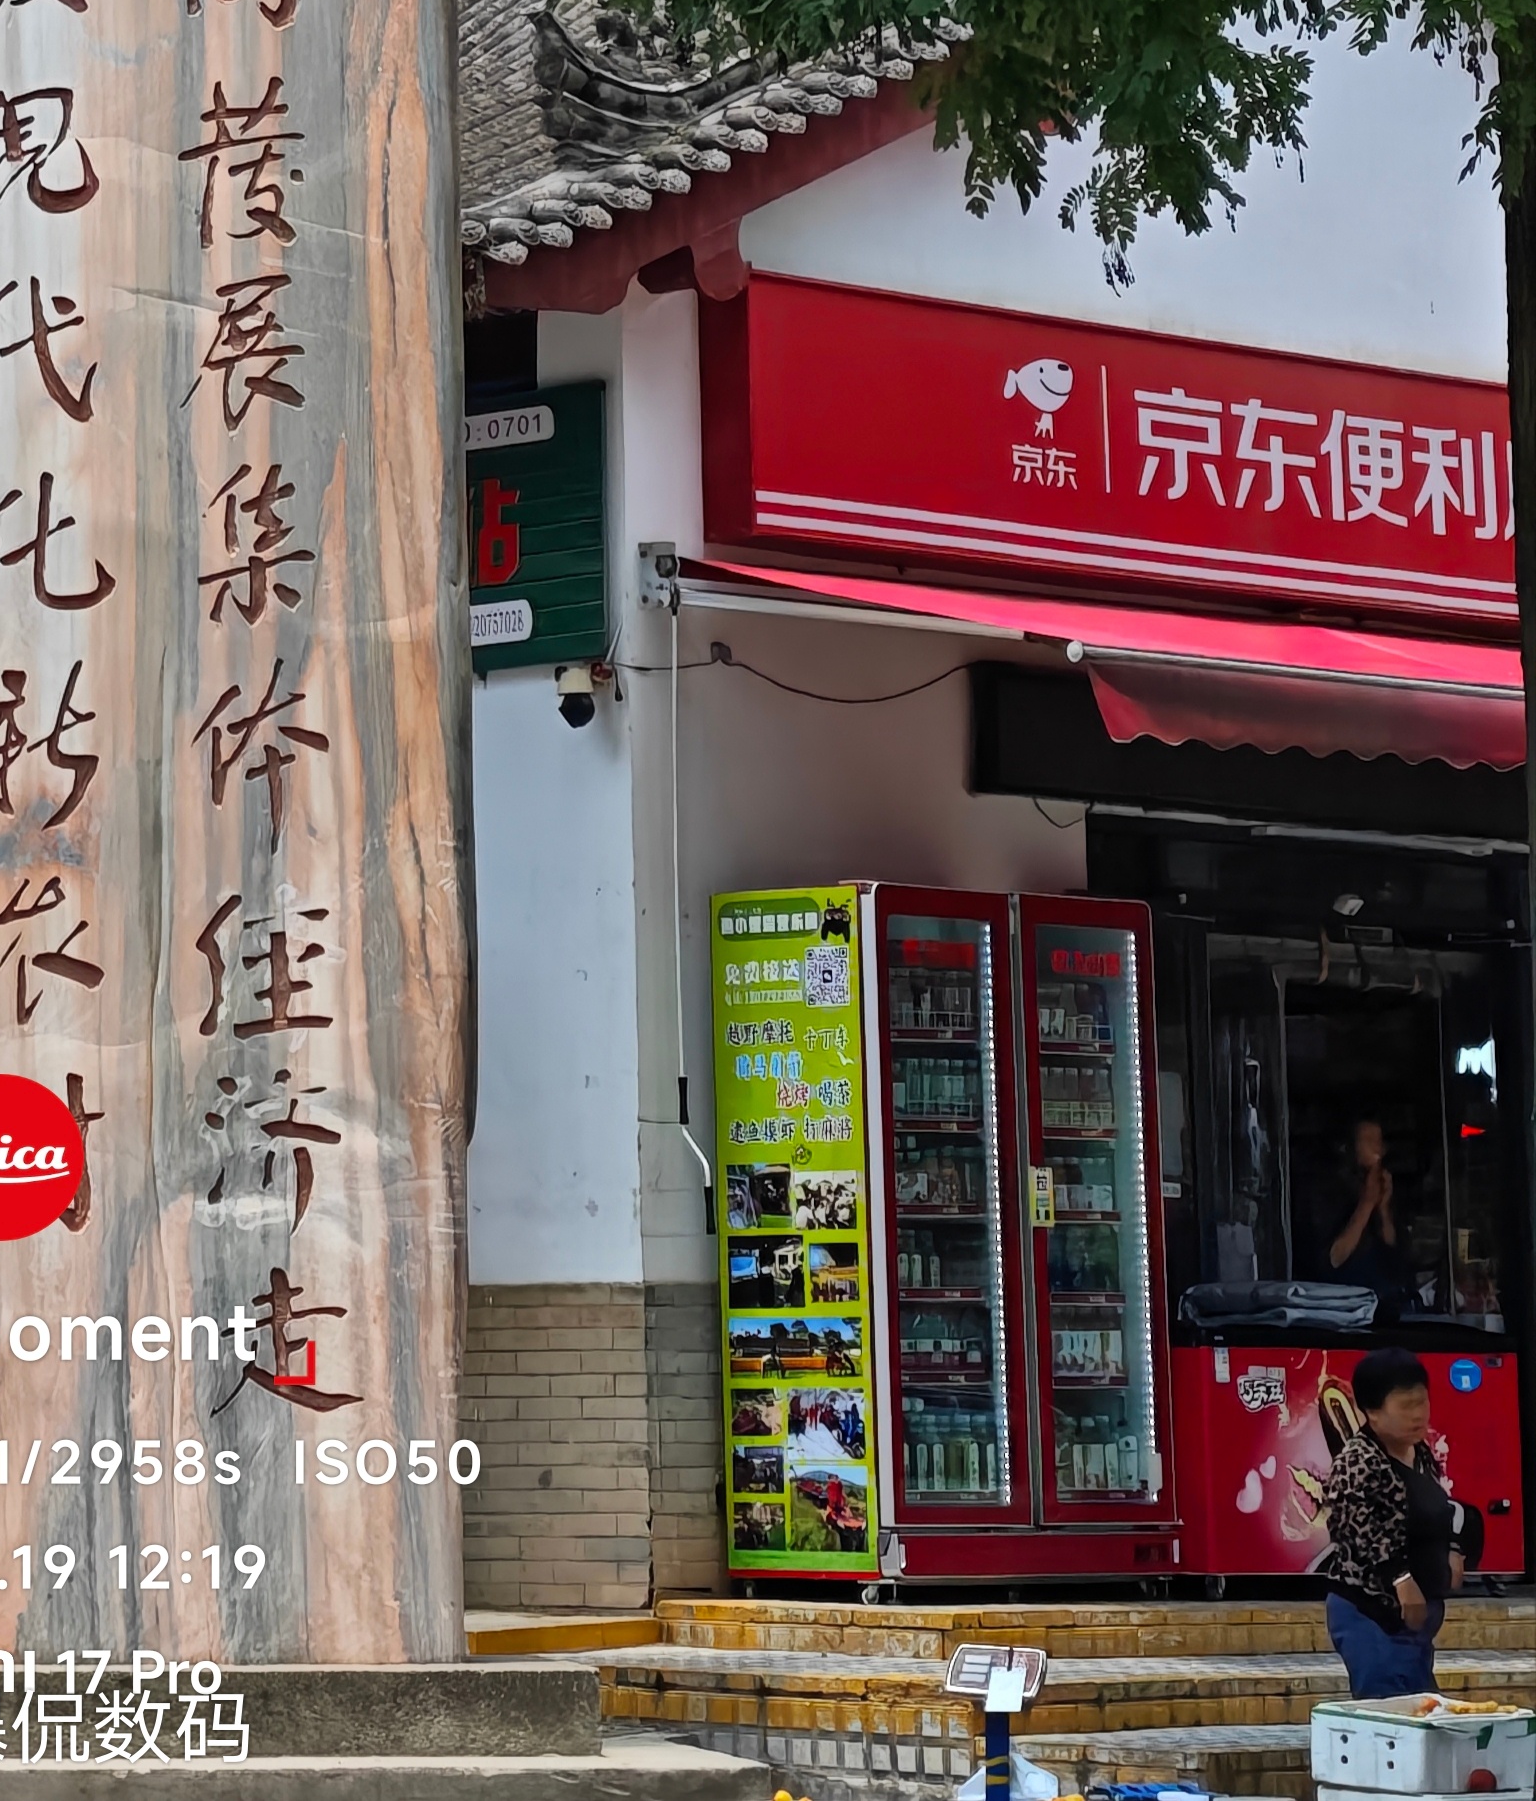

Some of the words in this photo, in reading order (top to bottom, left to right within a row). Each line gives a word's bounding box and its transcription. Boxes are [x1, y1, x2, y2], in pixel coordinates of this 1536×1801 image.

[1010, 443, 1079, 491] 京东
[1133, 386, 1517, 542] 京东便利
